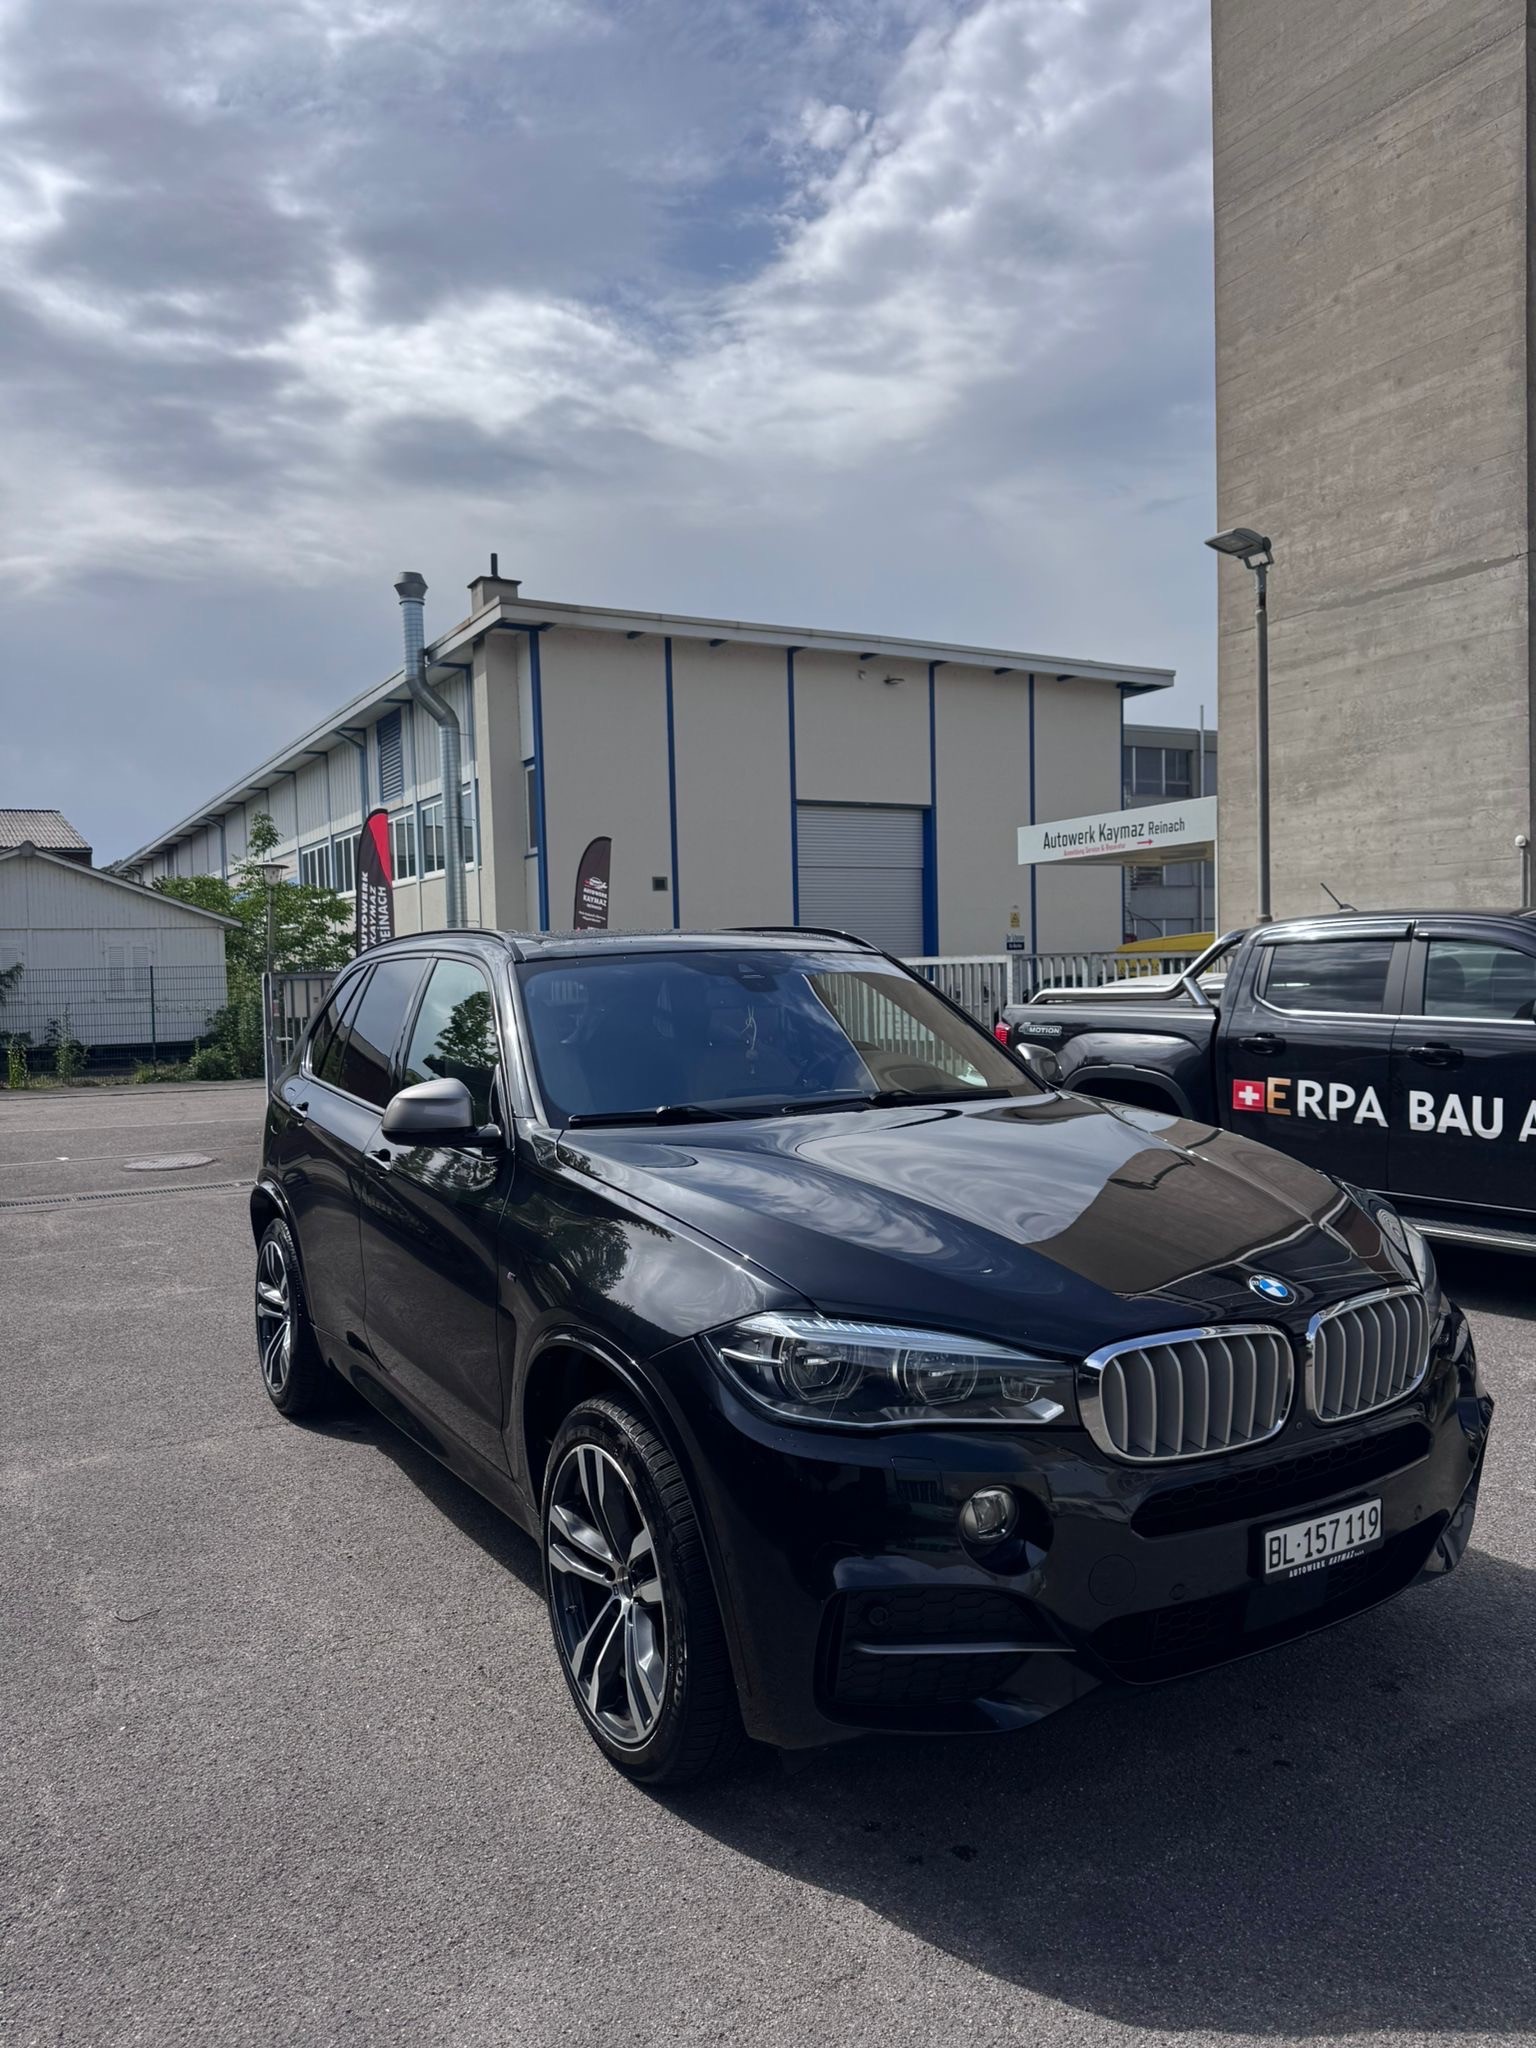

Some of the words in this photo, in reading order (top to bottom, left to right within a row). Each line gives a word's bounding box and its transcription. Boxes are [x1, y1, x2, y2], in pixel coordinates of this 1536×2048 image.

[1043, 826, 1095, 850] Autowerk
[1099, 823, 1145, 844] Kaymaz
[1148, 817, 1186, 836] Reinach
[583, 894, 607, 907] KAYMAZ
[1266, 1076, 1390, 1128] ERPA
[1409, 1090, 1504, 1139] BAU
[1288, 1559, 1326, 1578] AUTOWERK
